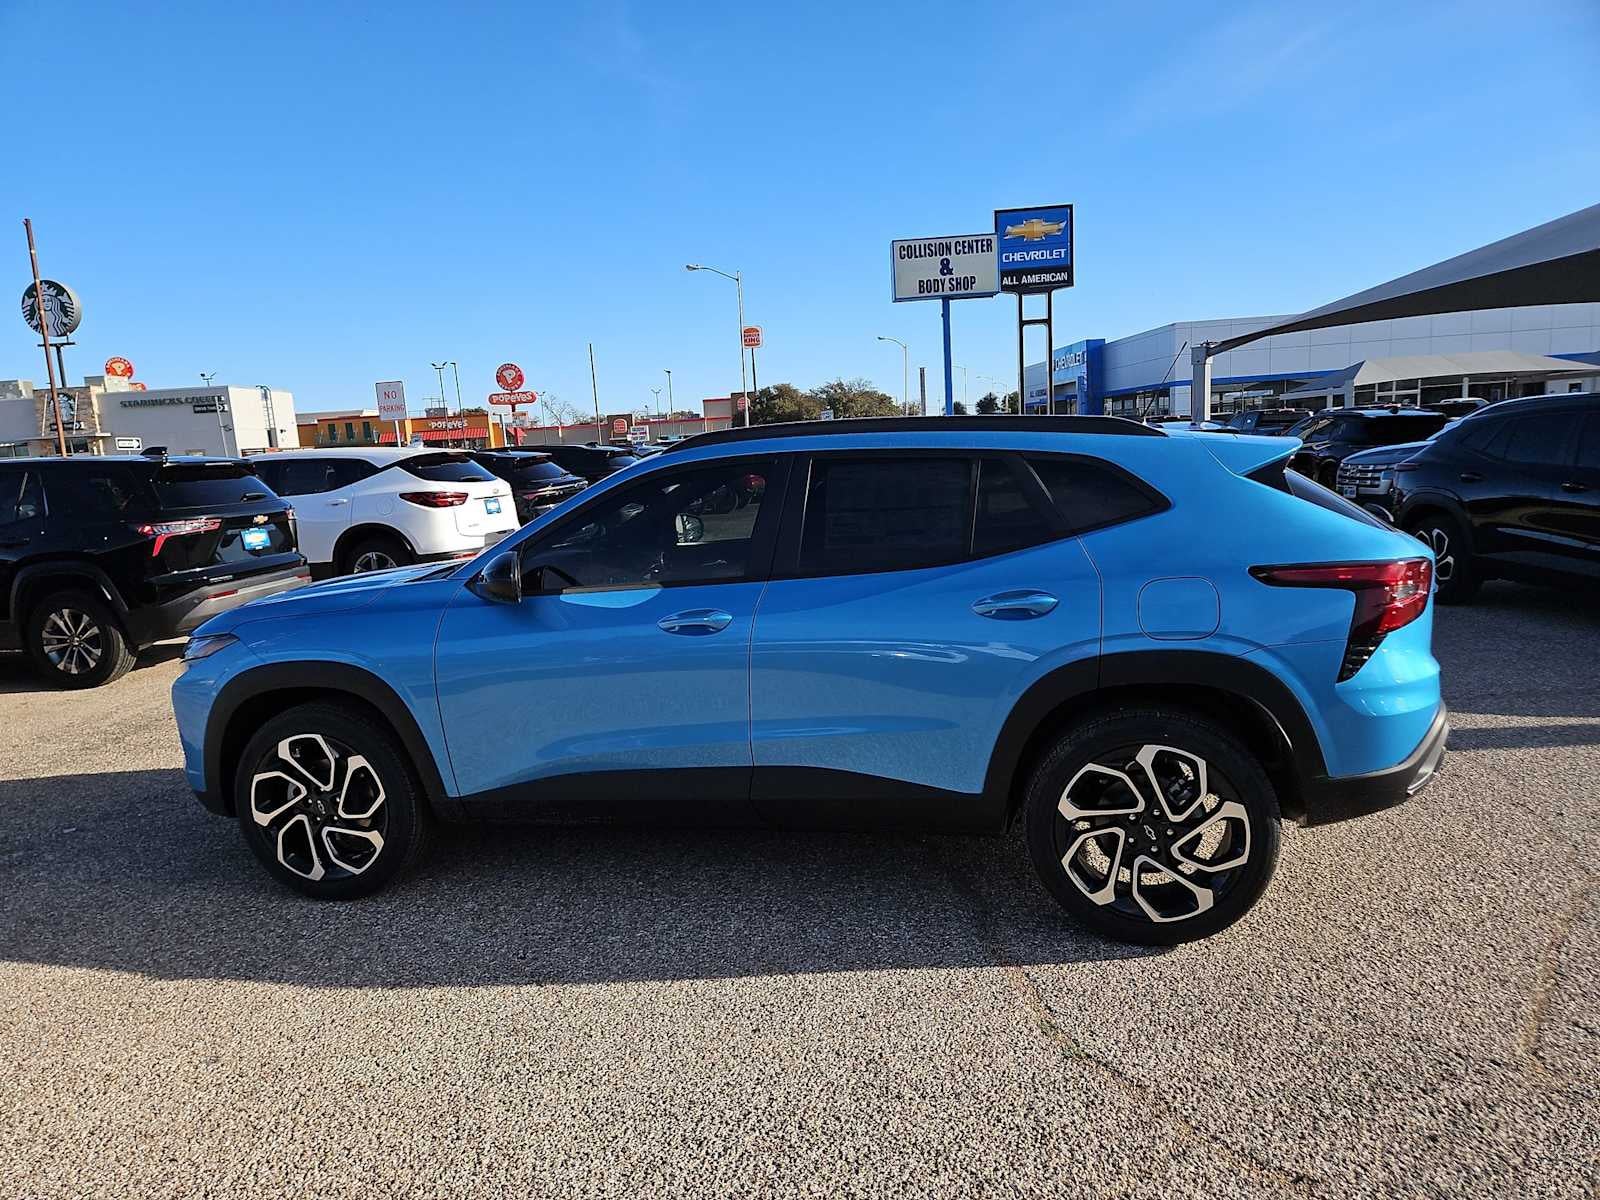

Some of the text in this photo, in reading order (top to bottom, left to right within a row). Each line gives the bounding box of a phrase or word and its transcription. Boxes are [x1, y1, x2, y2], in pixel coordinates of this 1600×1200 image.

[899, 239, 993, 259] COLLISION CENTER
[1003, 249, 1067, 262] CHEVROLET
[940, 258, 954, 276] &
[918, 276, 976, 294] BODY SHOP
[1003, 272, 1068, 285] ALL AMERICAN
[120, 398, 183, 408] STARBUCKS
[185, 395, 224, 404] COFFEE
[383, 390, 397, 400] NO
[380, 403, 405, 413] PARKING
